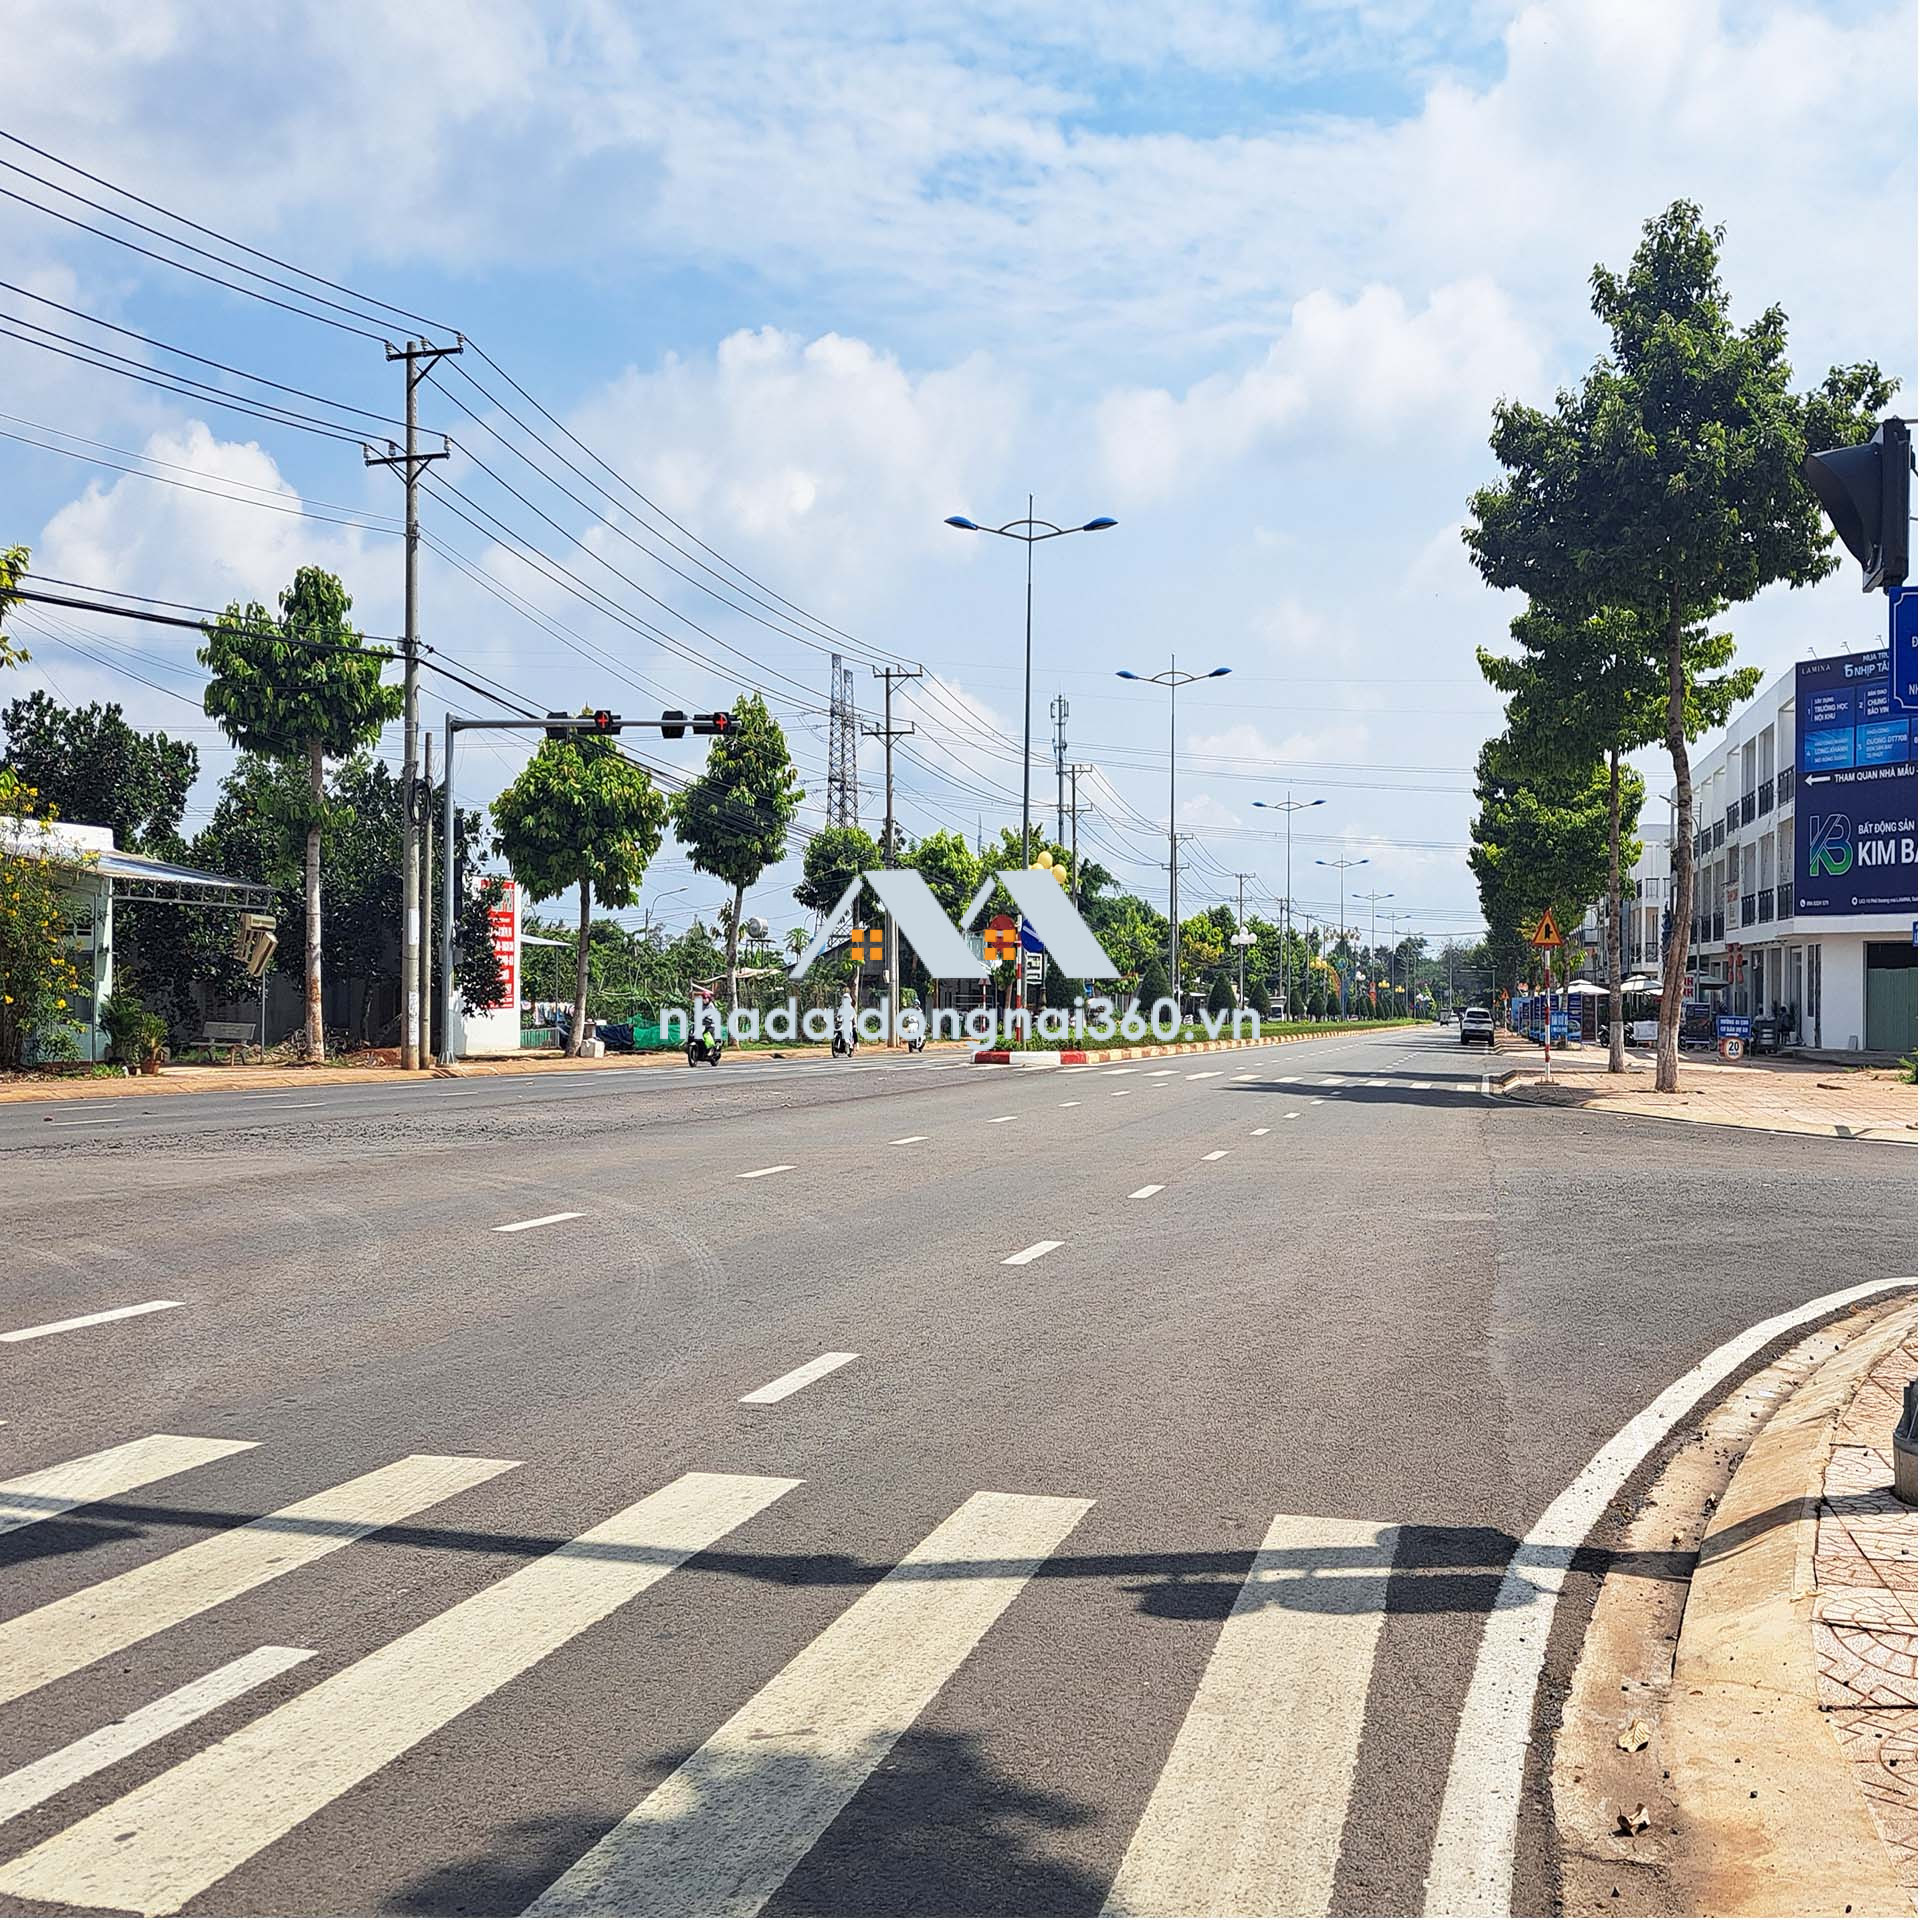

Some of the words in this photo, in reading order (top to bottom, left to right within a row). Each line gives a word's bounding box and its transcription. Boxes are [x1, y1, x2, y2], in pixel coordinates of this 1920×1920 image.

[1802, 664, 1831, 675] LAMINA
[1854, 664, 1876, 677] NHỊP
[1836, 702, 1849, 711] HỌC
[1834, 773, 1855, 783] THAM
[1857, 770, 1878, 781] QUAN
[1880, 767, 1896, 779] NHÀ
[1897, 764, 1916, 777] MẪU
[1858, 821, 1874, 834] BẤT
[1874, 820, 1897, 834] ĐỘNG
[1898, 818, 1915, 831] SẢN
[1858, 839, 1896, 866] KIM
[1901, 838, 1918, 863] B
[1728, 1041, 1739, 1051] 20
